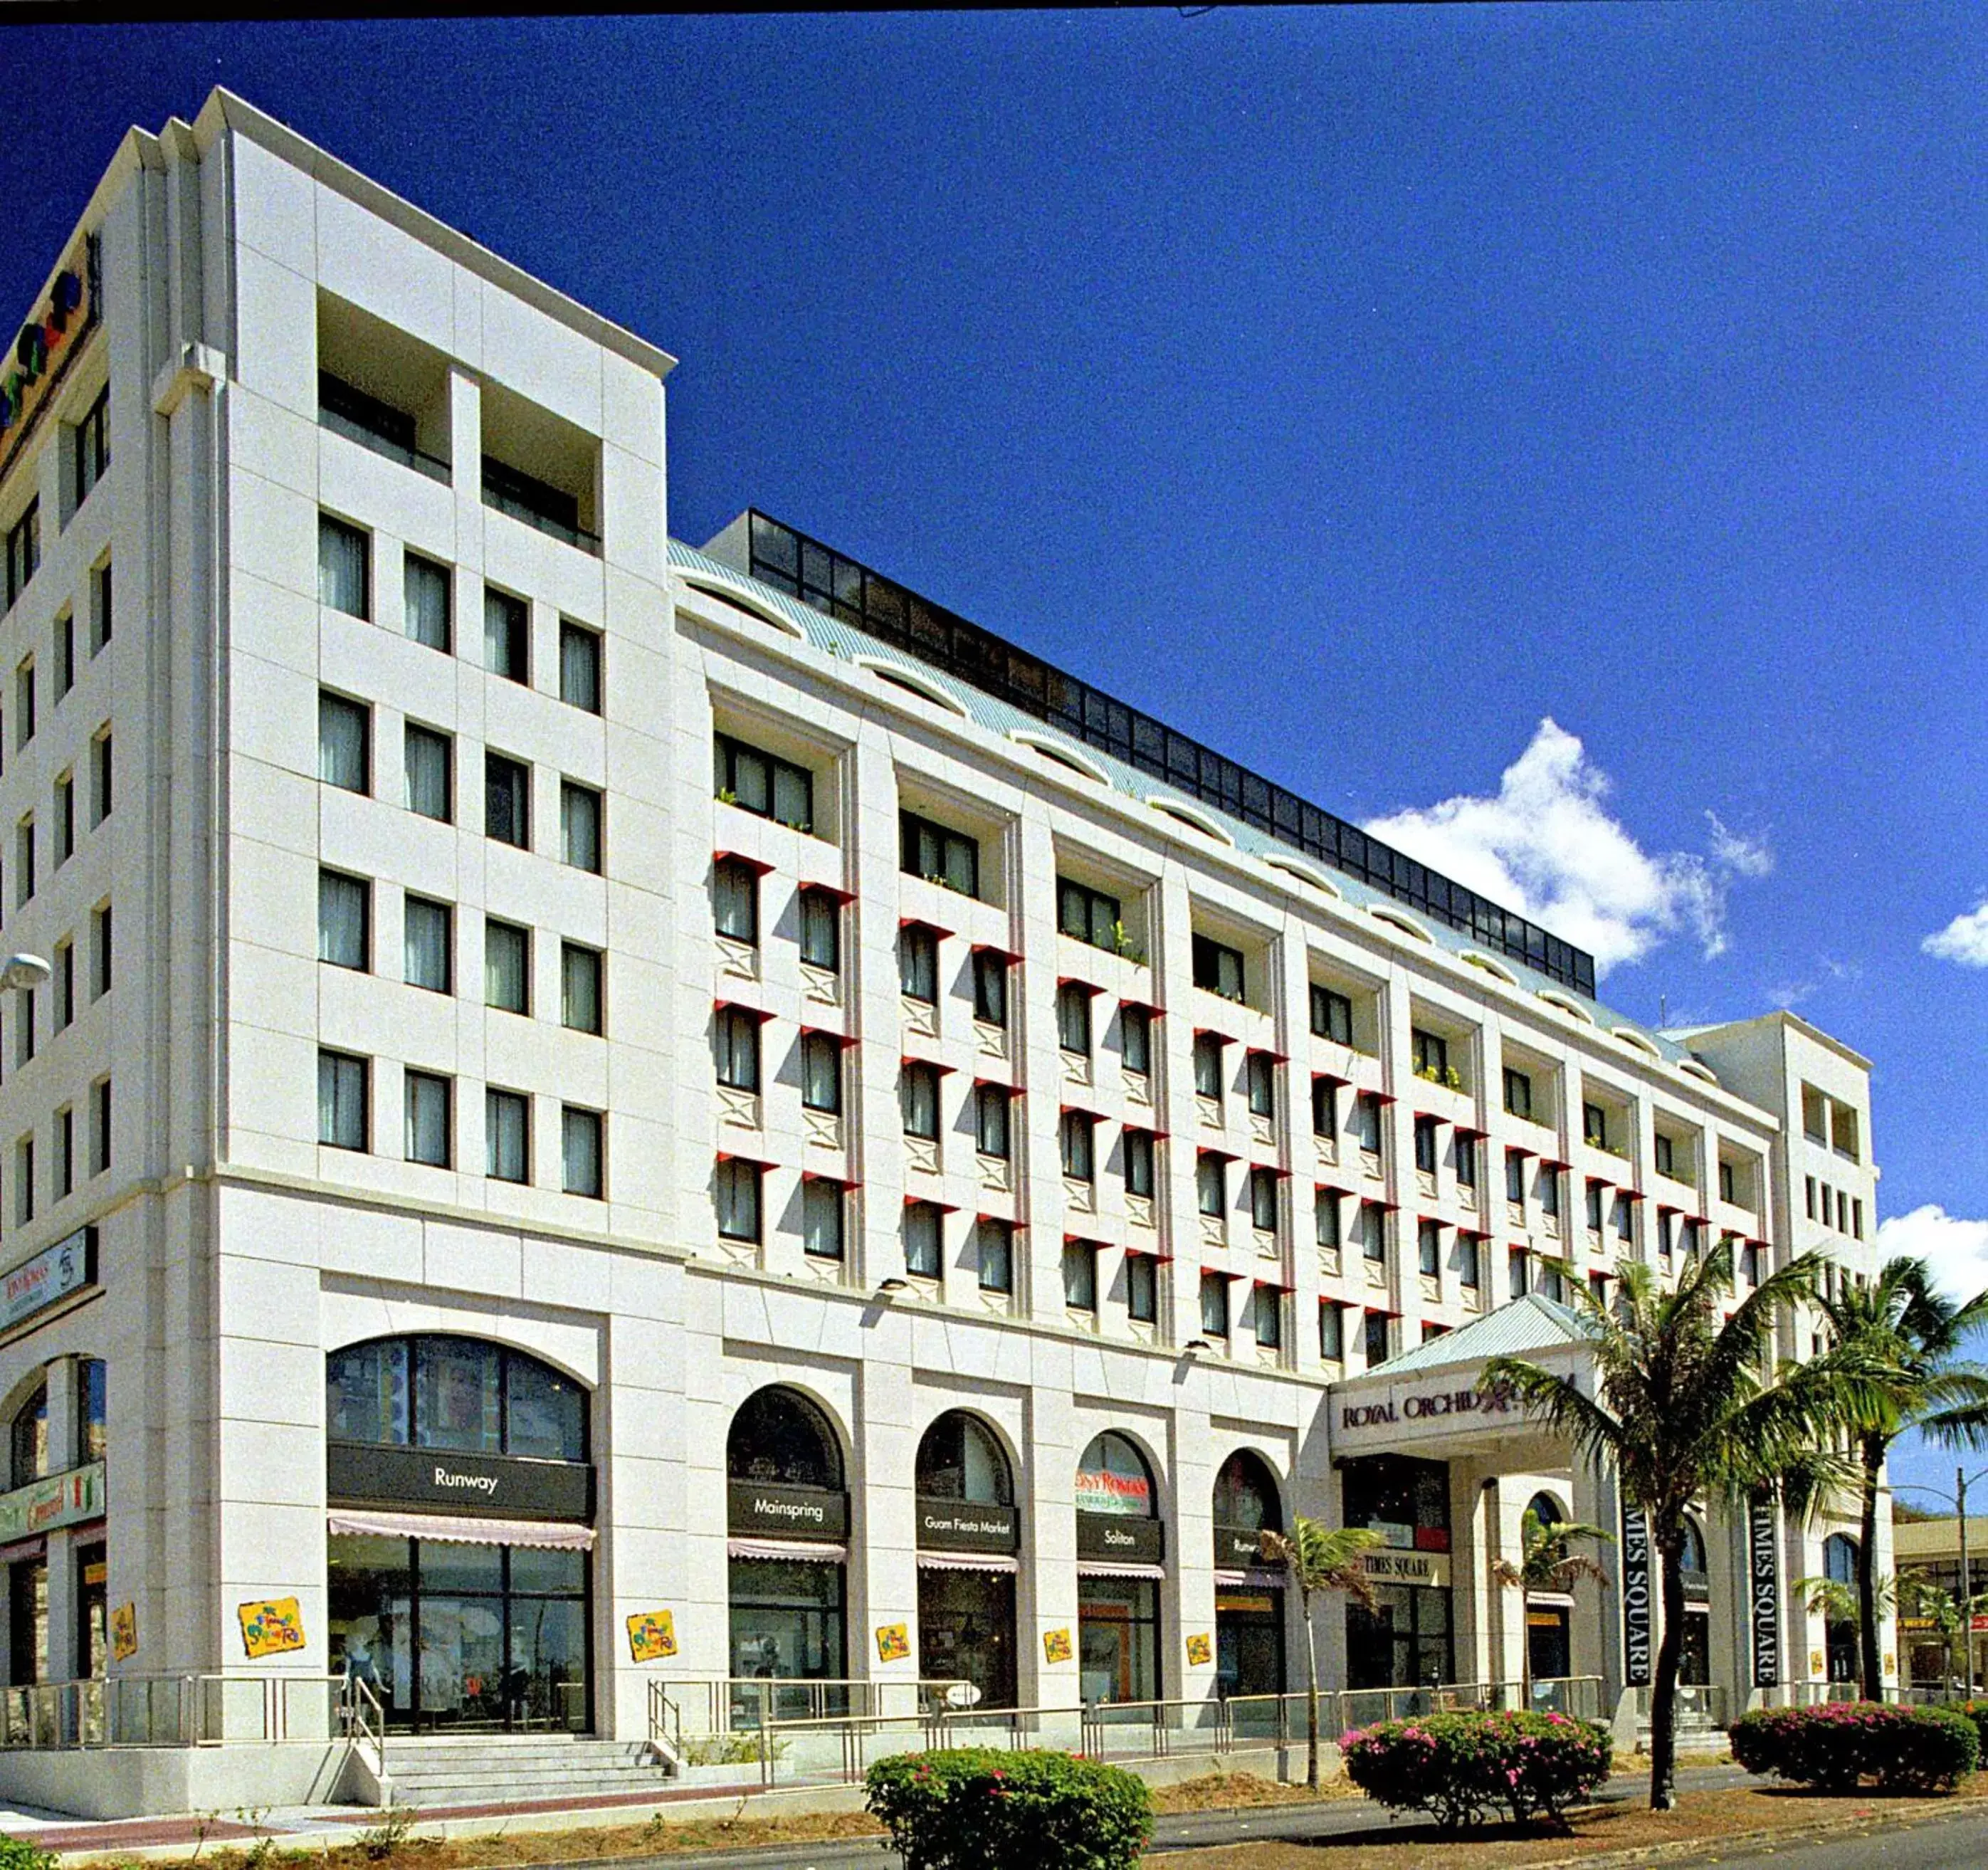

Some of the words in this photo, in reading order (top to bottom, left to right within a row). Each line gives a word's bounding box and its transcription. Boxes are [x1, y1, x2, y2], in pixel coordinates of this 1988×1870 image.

[1342, 1401, 1399, 1429] ROYAL
[1403, 1389, 1483, 1420] ORCHID
[435, 1468, 498, 1494] Runway
[754, 1498, 824, 1522] Mainspring
[925, 1516, 952, 1530] Guam
[954, 1518, 979, 1533] Fiesta
[980, 1520, 1010, 1534] Market
[1625, 1507, 1647, 1563] MES
[1364, 1555, 1392, 1575] TIMES
[1394, 1556, 1429, 1580] SQUARE
[1626, 1570, 1649, 1681] SQUARE
[1753, 1583, 1777, 1683] SQUARE
